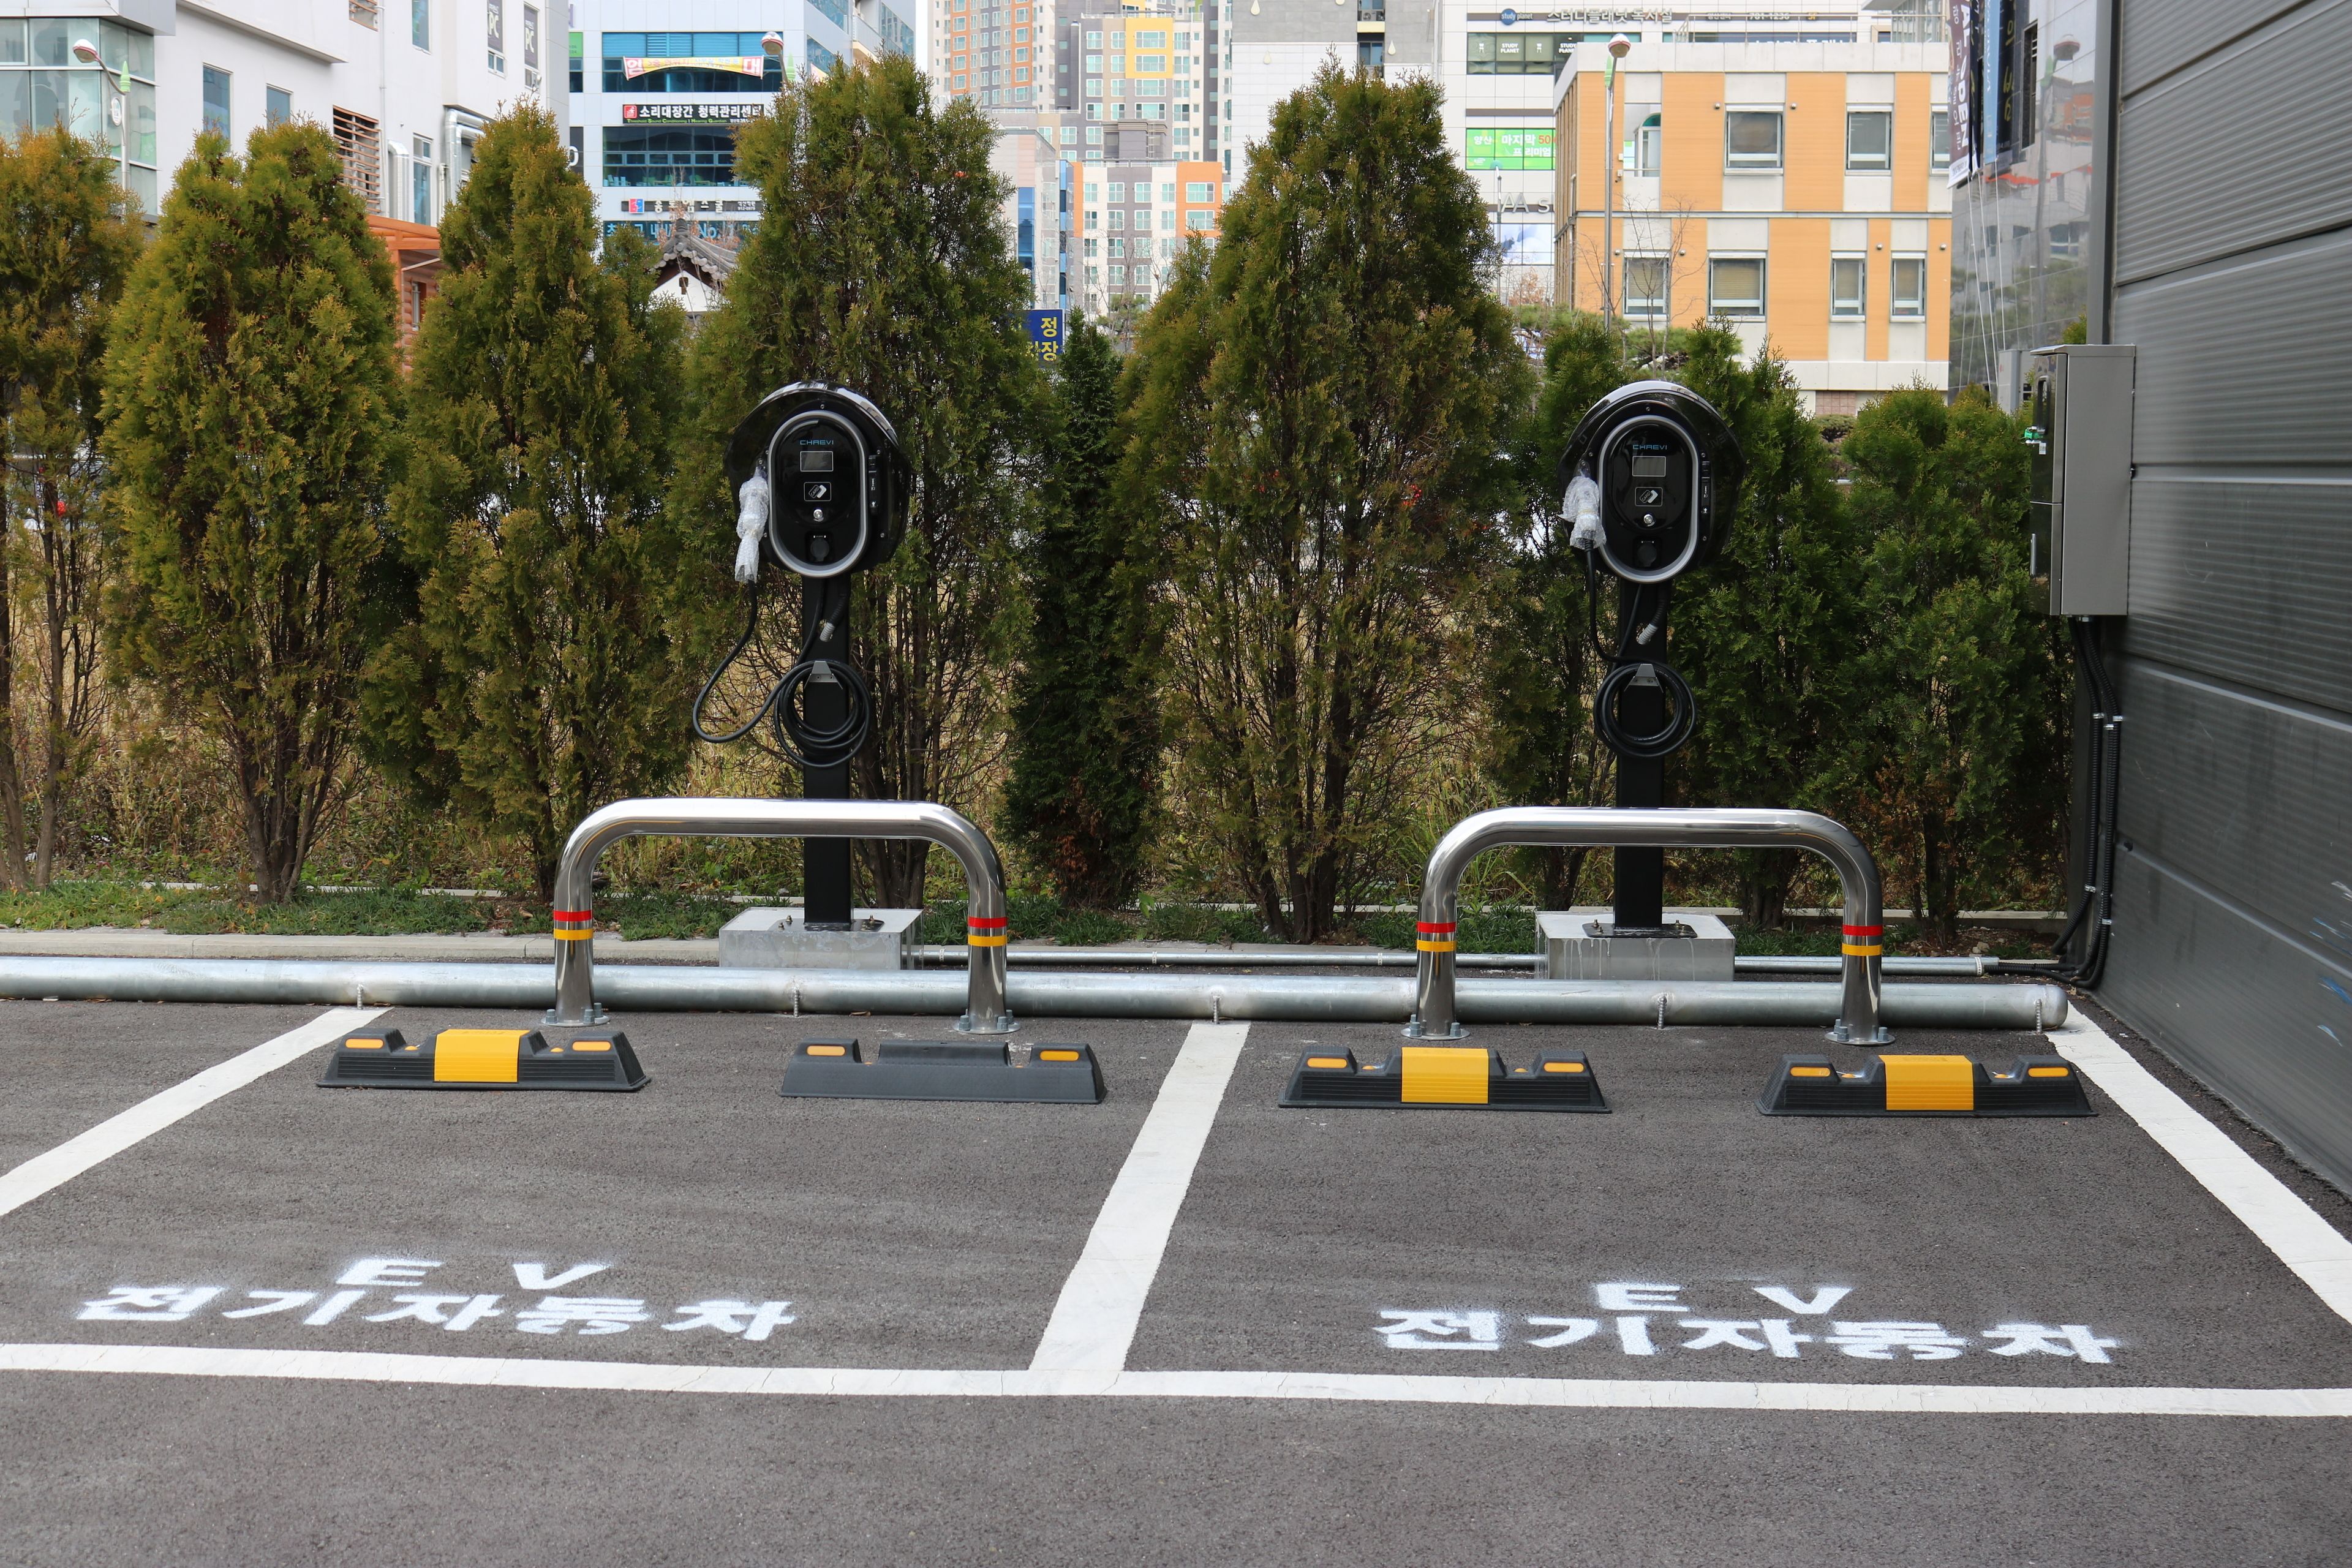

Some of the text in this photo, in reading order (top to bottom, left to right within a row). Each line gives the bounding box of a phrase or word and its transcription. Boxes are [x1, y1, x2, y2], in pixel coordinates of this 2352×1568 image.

[1501, 12, 1533, 21] study planet
[1547, 8, 1673, 23] 스터디플래닛 독서실
[489, 11, 499, 39] PC
[525, 27, 535, 53] PC
[639, 105, 761, 119] 소리대장간 청력관리센터
[1474, 135, 1492, 145] 양산
[1502, 135, 1536, 146] 마지막
[1513, 147, 1551, 157] 프리미엄
[810, 487, 820, 496] CARD
[1642, 492, 1651, 501] CARD
[75, 1285, 796, 1341] 전기자동차
[1374, 1310, 2117, 1363] 전기자동차
